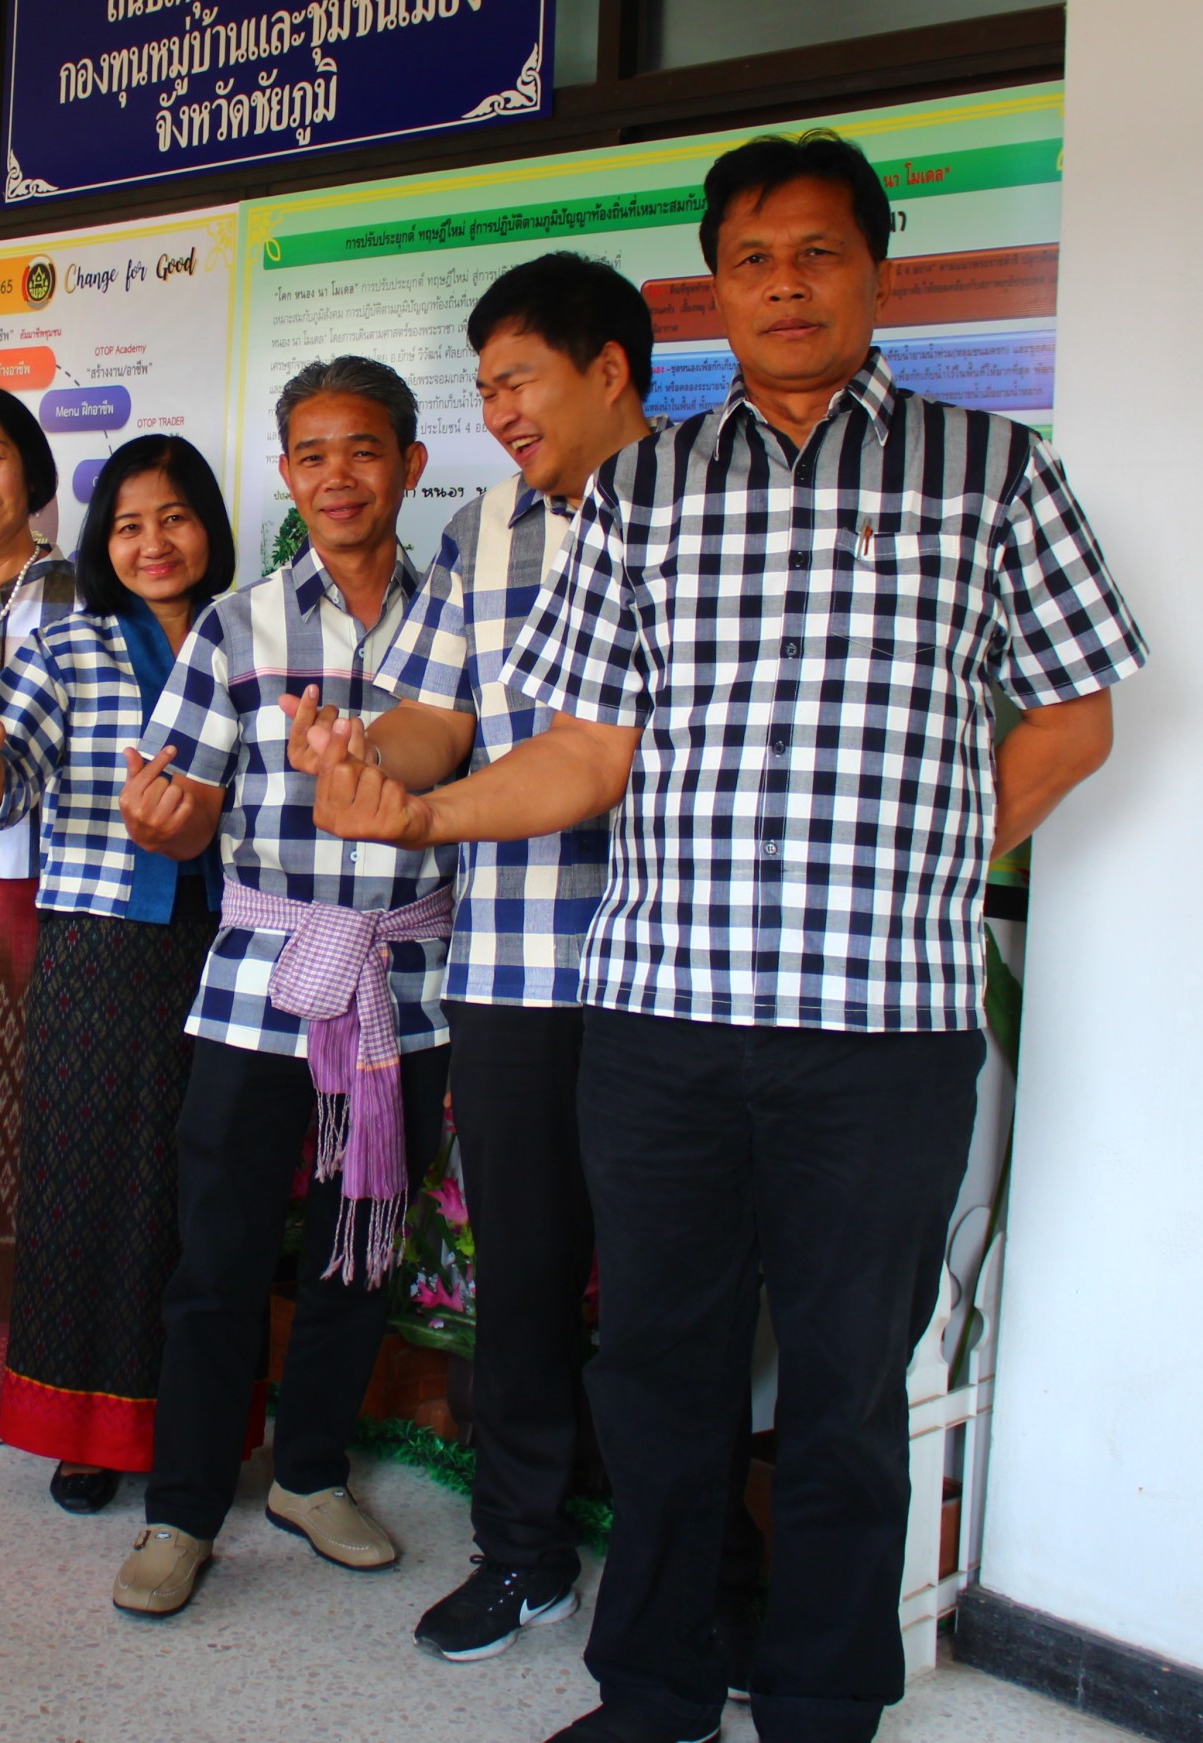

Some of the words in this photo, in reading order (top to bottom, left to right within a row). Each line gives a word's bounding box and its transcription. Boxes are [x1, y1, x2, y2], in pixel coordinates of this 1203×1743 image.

[156, 57, 337, 153] จังหวัดชัยภูมิ
[346, 224, 416, 250] การปรับประยุกต์
[418, 218, 465, 245] ทฤษฎีใหม่
[65, 263, 118, 294] Change
[125, 259, 147, 292] for
[156, 247, 197, 281] Good
[294, 289, 315, 300] หนอง
[318, 288, 328, 297] นา
[94, 346, 114, 357] OTOP
[115, 344, 146, 355] Academy
[55, 405, 79, 418] Menu
[81, 400, 114, 417] ฝึกอาชีพ
[136, 418, 157, 428] OTOP
[158, 416, 185, 427] TRADER
[465, 422, 470, 433] 4
